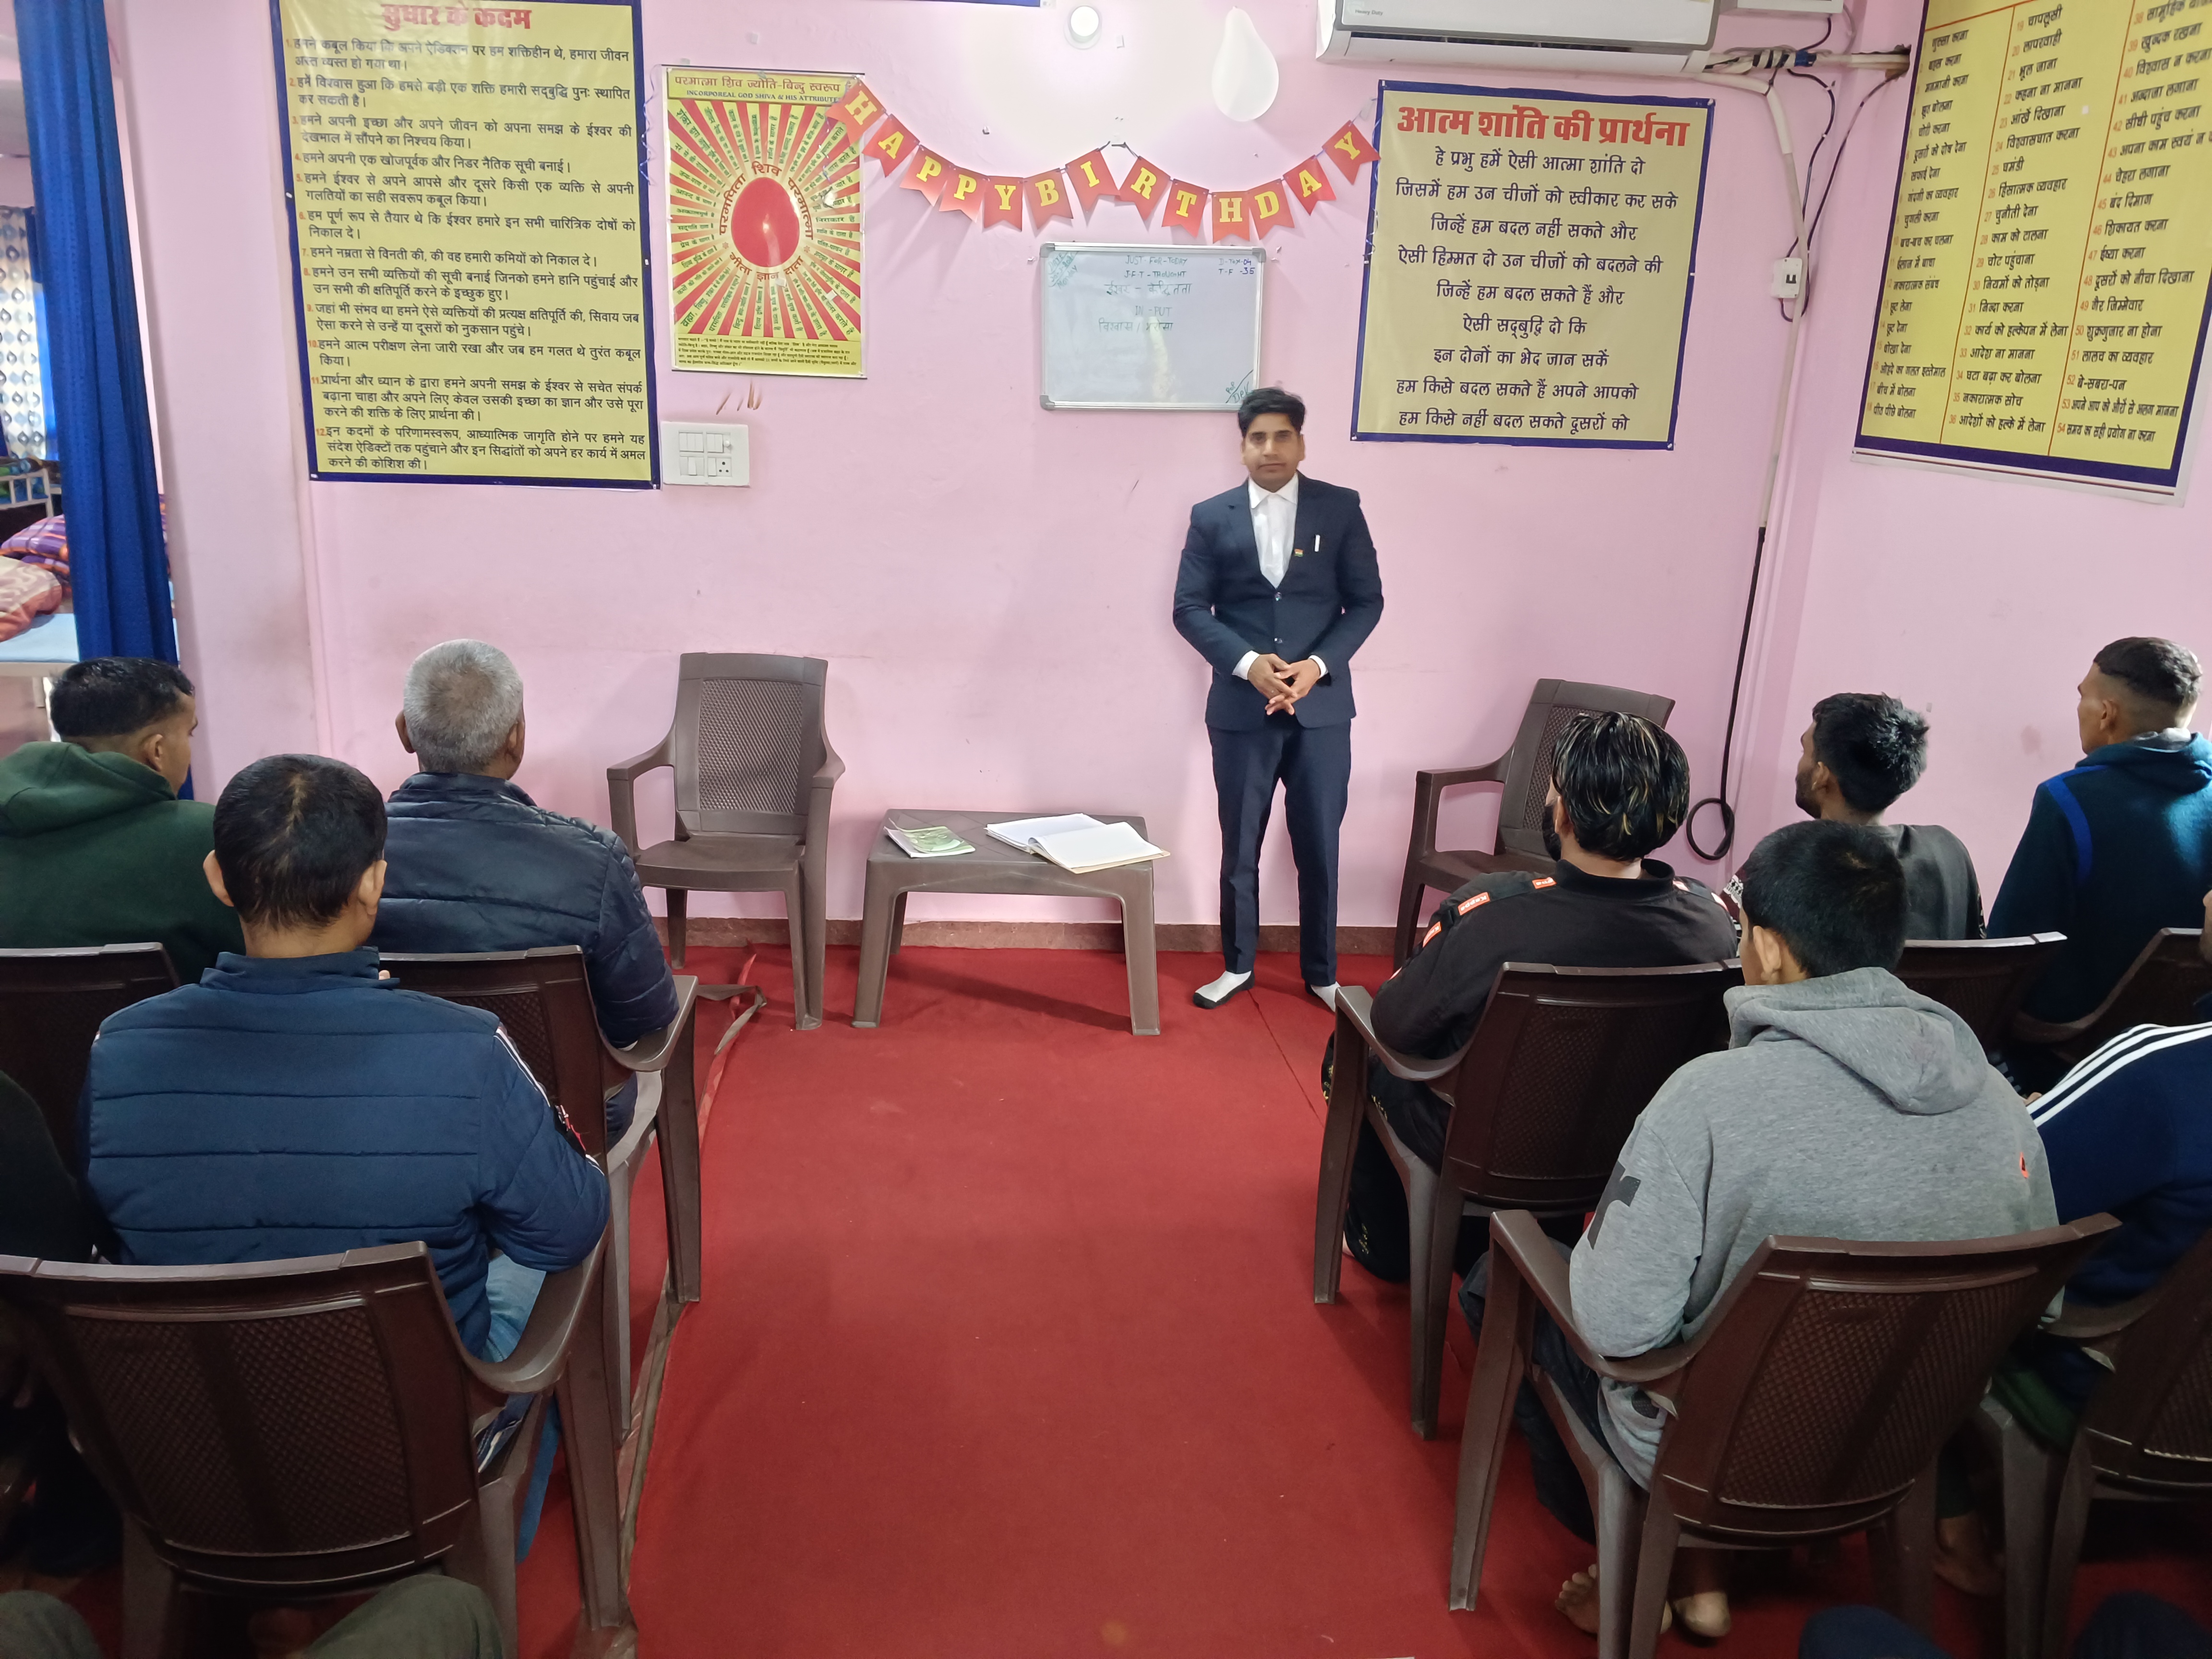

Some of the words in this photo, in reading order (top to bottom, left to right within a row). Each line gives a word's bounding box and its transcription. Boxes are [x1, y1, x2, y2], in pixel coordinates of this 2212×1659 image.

[381, 4, 440, 31] सुधार
[474, 7, 532, 29] कदम
[2023, 29, 2062, 52] लापरवाही
[2174, 22, 2203, 41] रखना
[297, 73, 311, 87] हमें
[315, 74, 353, 89] विश्वास
[356, 80, 377, 93] हुआ
[380, 77, 394, 90] कि
[398, 78, 422, 91] हमसे
[426, 79, 446, 94] बड़ी
[450, 83, 467, 94] एक
[471, 81, 495, 94] शक्ति
[499, 82, 527, 95] हमारी
[572, 87, 590, 101] पुनः
[593, 85, 630, 99] स्थापित
[675, 77, 717, 85] परमात्मा
[722, 76, 743, 88] शिव
[809, 83, 841, 92] स्वरूप
[2015, 86, 2038, 101] कहना
[2040, 84, 2051, 95] ना
[2053, 77, 2083, 93] मानना
[1397, 107, 1474, 135] आत्म
[1479, 105, 1550, 140] शांति
[1553, 109, 1595, 142] की
[1599, 112, 1690, 146] प्रार्थना
[751, 161, 782, 176] शिव
[1435, 146, 1446, 166] हे
[1451, 152, 1475, 172] प्रभु
[1480, 147, 1503, 168] हमें
[1508, 150, 1538, 170] ऐसी
[1542, 156, 1585, 171] आत्मा
[1589, 153, 1626, 174] शांति
[1631, 156, 1646, 175] दो
[720, 173, 746, 235] परमपिता
[1395, 177, 1442, 197] जिसमें
[1447, 185, 1470, 200] हम
[1474, 186, 1498, 200] उन
[1502, 182, 1540, 203] चीजों
[1545, 186, 1564, 204] को
[1569, 186, 1621, 207] स्वीकार
[1624, 194, 1647, 208] कर
[1651, 192, 1679, 209] सके
[789, 177, 813, 240] परमात्मा
[1996, 204, 2021, 224] चुनौती
[2023, 204, 2039, 218] देना
[1431, 212, 1467, 234] जिन्हें
[1471, 219, 1494, 234] हम
[1498, 221, 1531, 235] बदल
[1535, 217, 1563, 238] नहीं
[1567, 221, 1606, 239] सकते
[1610, 220, 1638, 240] और
[2104, 219, 2142, 236] शिकायत
[2144, 219, 2169, 231] करना
[730, 252, 752, 275] गीता
[783, 256, 804, 275] दाता
[1398, 244, 1428, 264] ऐसी
[1432, 246, 1478, 266] हिम्मत
[1482, 249, 1498, 267] दो
[1502, 254, 1526, 267] उन
[1530, 250, 1568, 269] चीजों
[1573, 252, 1592, 270] को
[1596, 255, 1640, 273] बदलने
[1644, 255, 1664, 273] की
[757, 272, 780, 281] ज्ञान
[2094, 269, 2117, 291] दूसरों
[2120, 270, 2132, 285] को
[2134, 268, 2156, 284] नीचा
[2158, 268, 2195, 284] दिखाना
[2003, 302, 2024, 313] करना
[1463, 313, 1492, 332] ऐसी
[1549, 316, 1564, 334] दो
[1568, 316, 1587, 335] कि
[1434, 349, 1455, 363] इन
[1459, 345, 1492, 363] दोनों
[1496, 351, 1516, 364] का
[1521, 348, 1542, 366] भेद
[1546, 353, 1577, 366] जान
[1582, 349, 1609, 367] सकें
[2082, 351, 2106, 362] लालच
[2108, 351, 2120, 362] का
[2122, 351, 2154, 365] व्यवहार
[1963, 393, 2003, 405] नकारात्मक
[2005, 392, 2023, 406] सोच
[1399, 411, 1421, 426] हम
[1426, 408, 1457, 426] किसे
[1462, 409, 1489, 428] नहीं
[1493, 415, 1525, 428] बदल
[1529, 412, 1567, 429] सकते
[1570, 411, 1607, 435] दूसरों
[1611, 414, 1630, 431] को
[326, 439, 353, 452] संदेश
[394, 444, 411, 453] तक
[414, 442, 447, 457] पहुंचाने
[450, 442, 469, 454] और
[471, 446, 486, 456] इन
[527, 444, 541, 457] को
[544, 445, 567, 457] अपने
[570, 449, 583, 458] हर
[586, 446, 607, 458] कार्य
[609, 446, 618, 459] में
[620, 451, 646, 460] अमल
